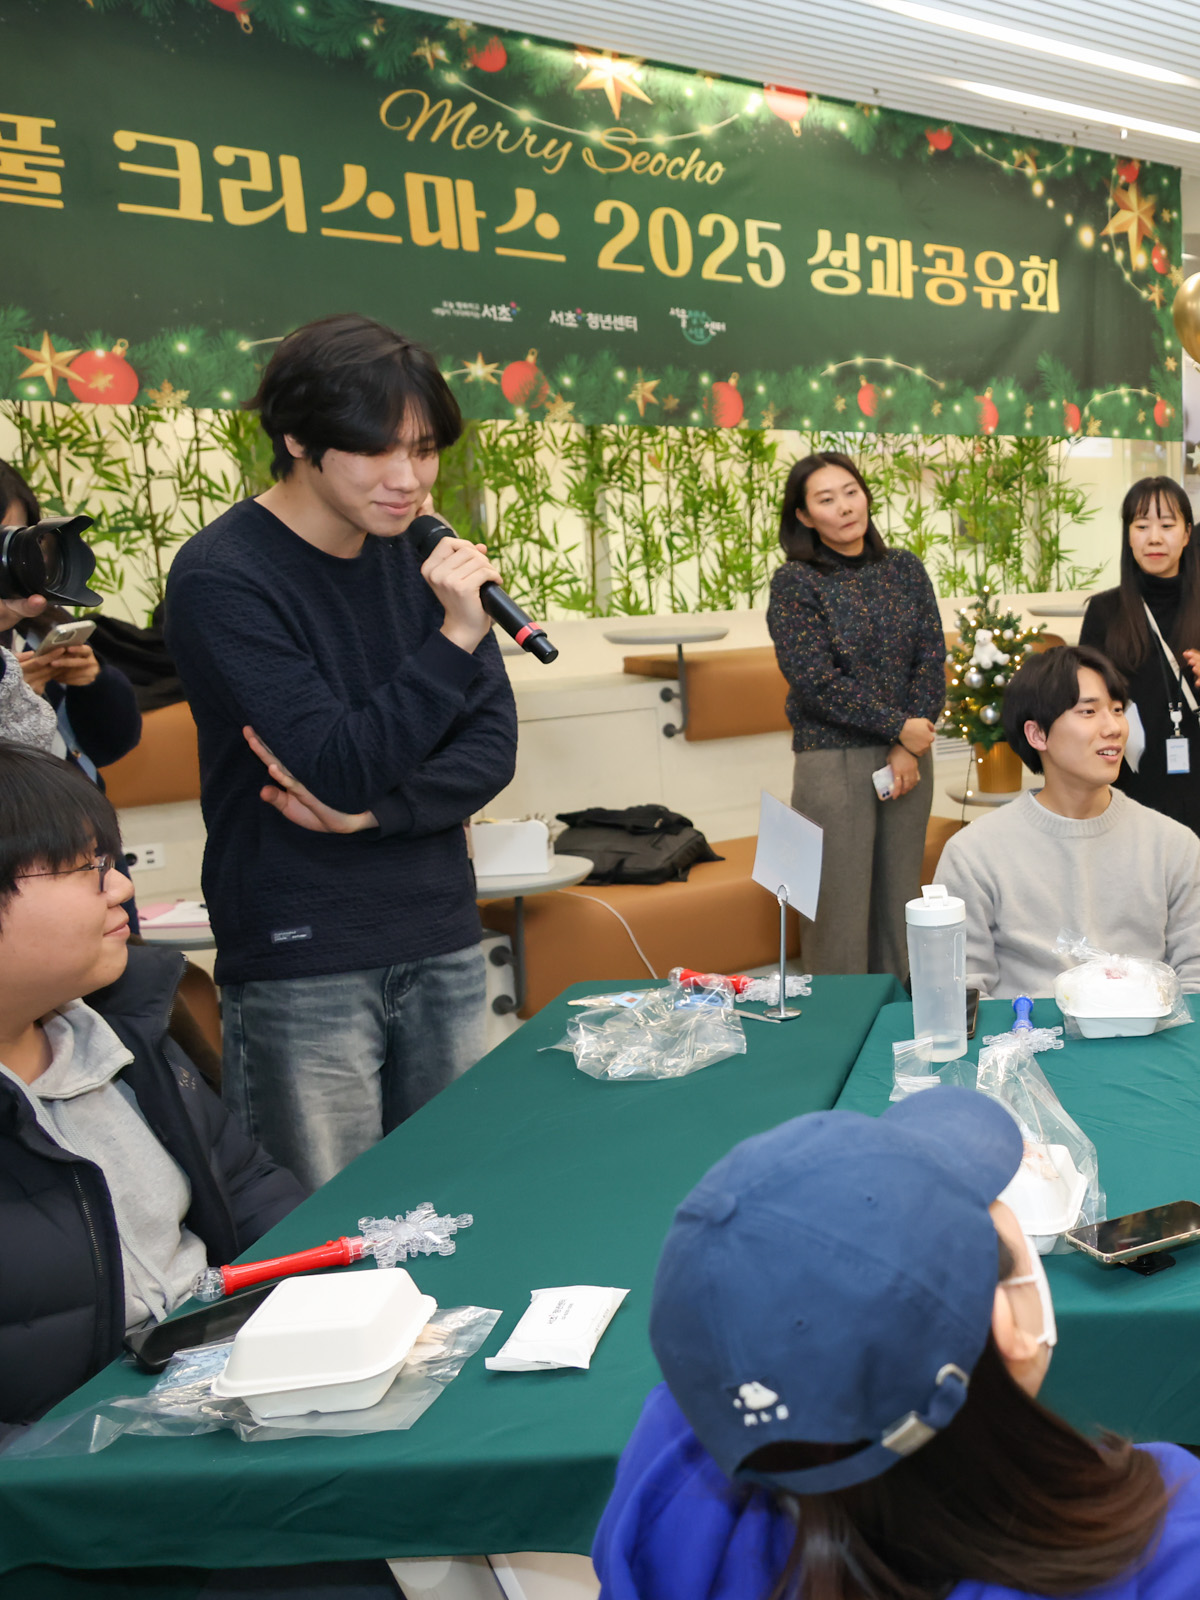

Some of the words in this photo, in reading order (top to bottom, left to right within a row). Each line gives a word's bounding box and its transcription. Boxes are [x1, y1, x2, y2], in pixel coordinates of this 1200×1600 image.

[379, 88, 573, 175] Merry
[581, 127, 727, 186] Seocho
[113, 129, 568, 264] 크리스마스
[594, 199, 787, 289] 2025
[806, 229, 1061, 313] 성과공유회
[481, 303, 514, 323] 서초
[549, 309, 579, 329] 서초
[585, 312, 638, 333] 청년센터
